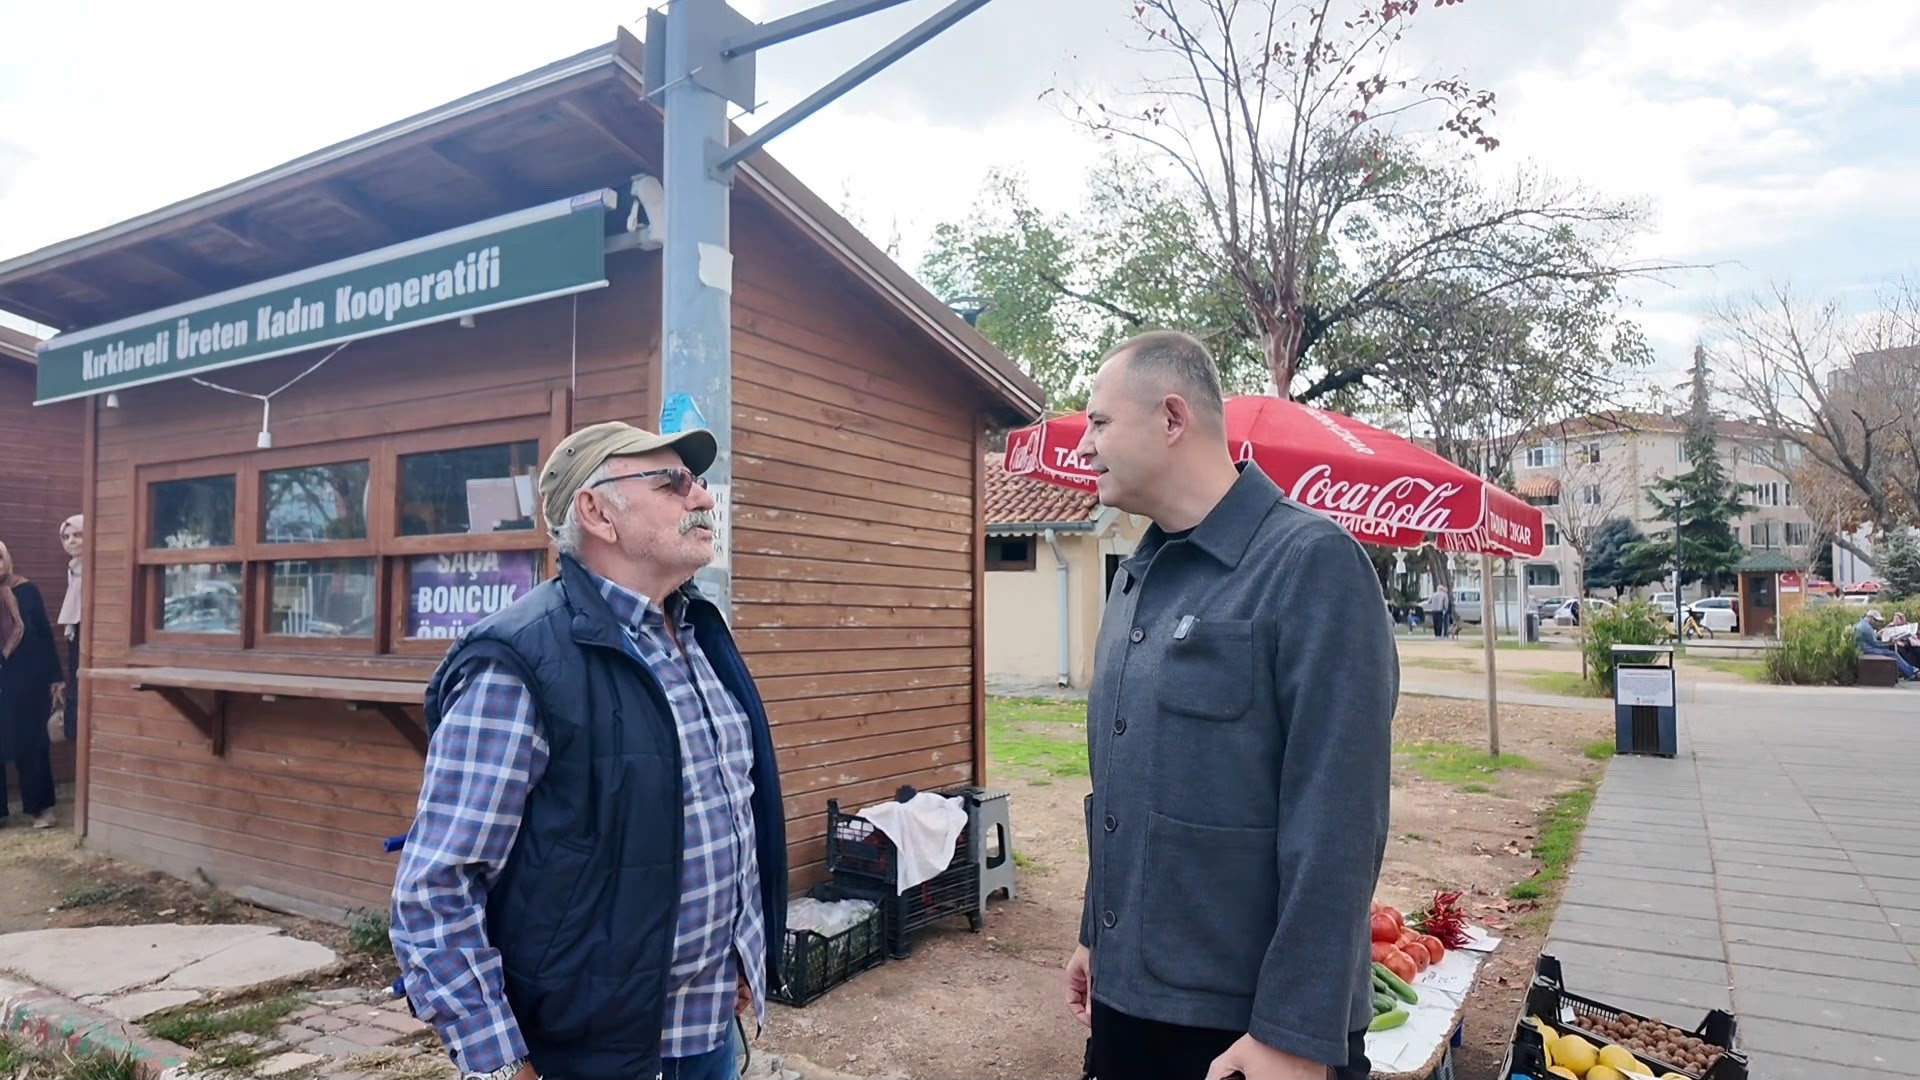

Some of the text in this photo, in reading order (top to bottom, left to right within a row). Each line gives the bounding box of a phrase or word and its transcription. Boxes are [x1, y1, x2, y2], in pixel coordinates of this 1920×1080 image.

[81, 246, 500, 381] Kırklareli Üreten Kadın Kooperatifi
[1288, 464, 1463, 531] Coca-Cola
[437, 551, 500, 580] SAÇA
[417, 584, 517, 614] BONCUK
